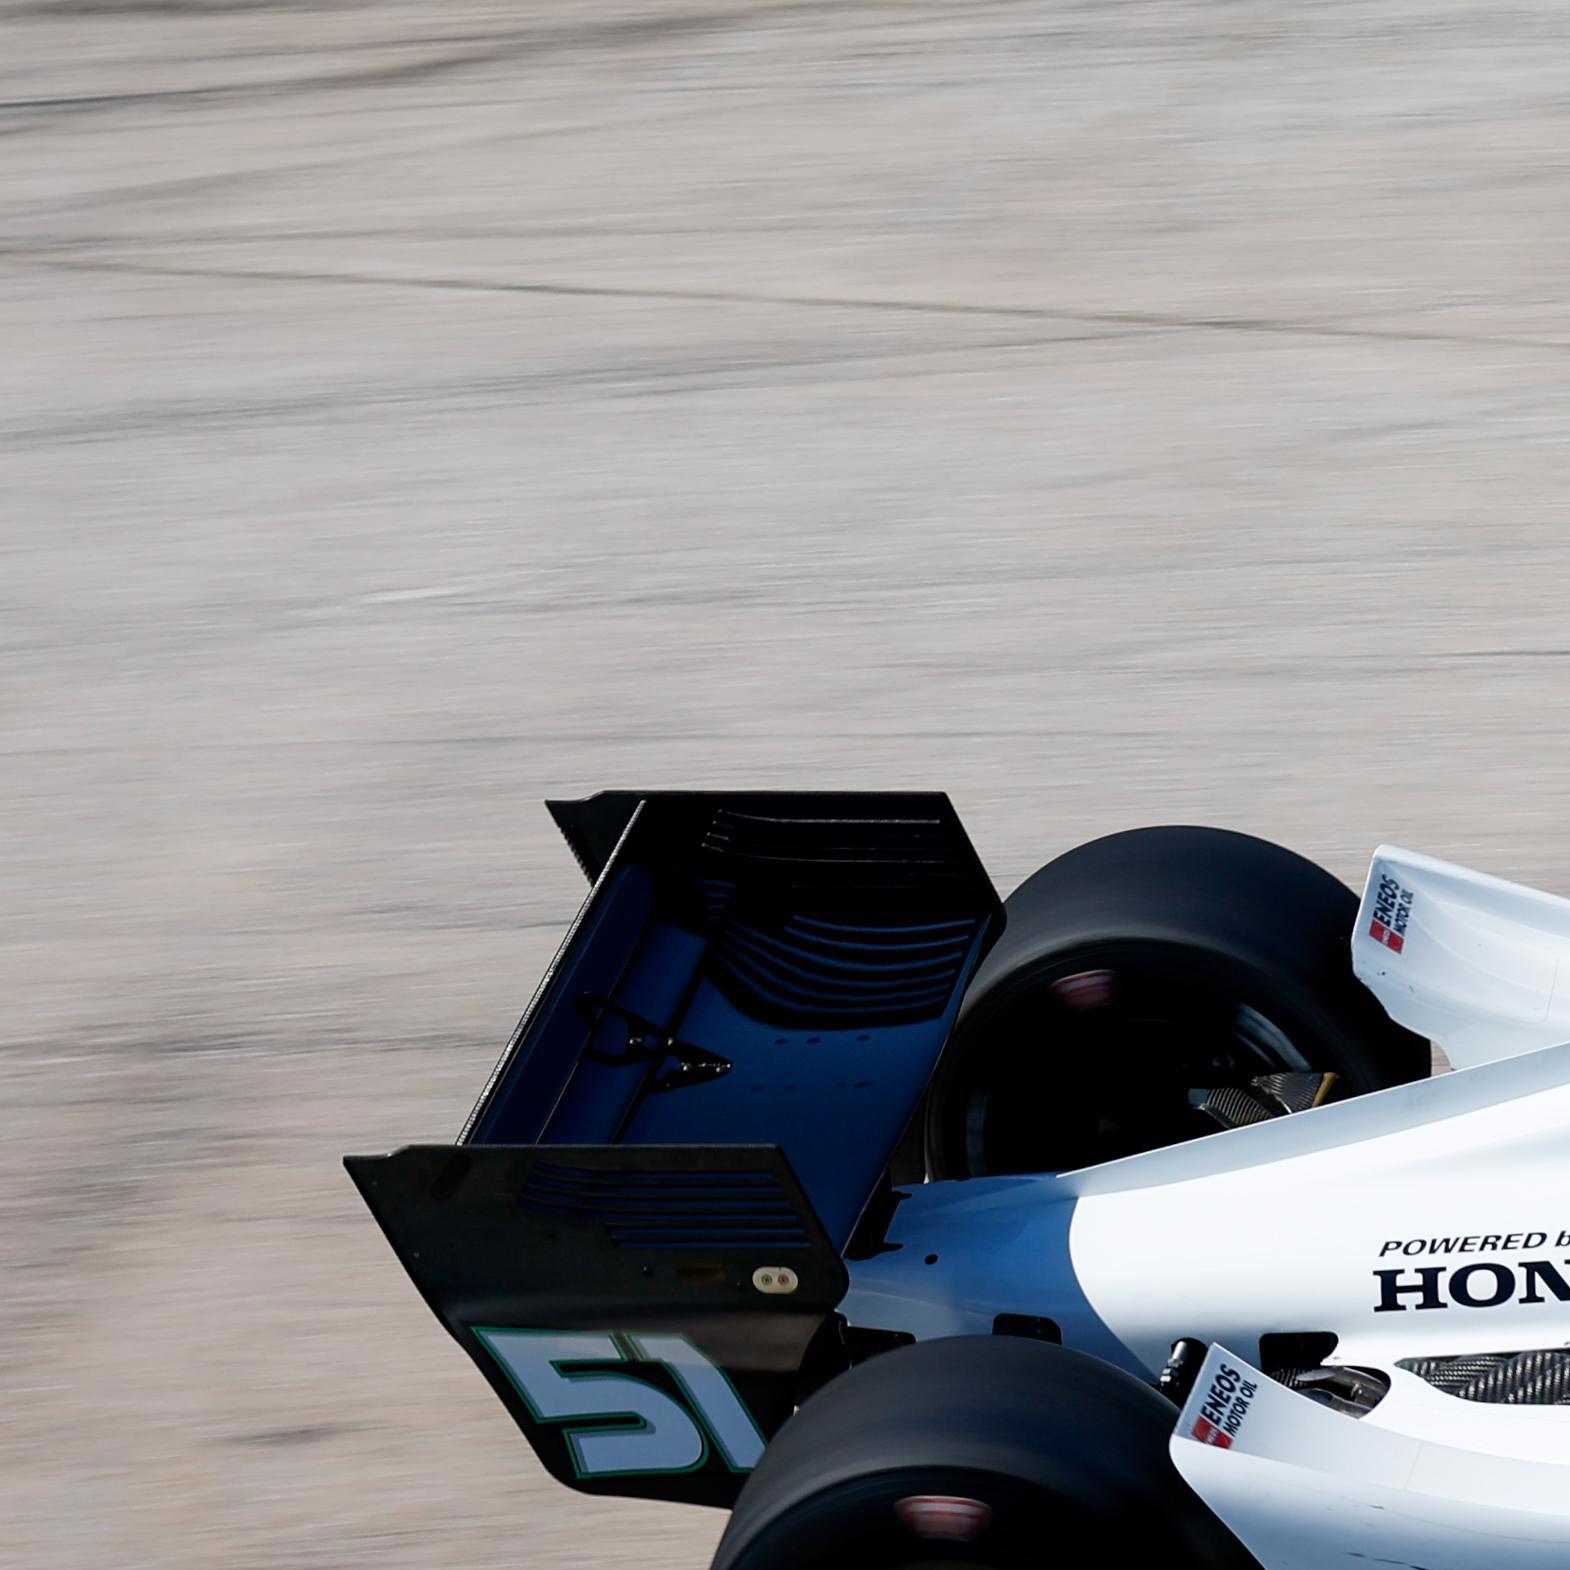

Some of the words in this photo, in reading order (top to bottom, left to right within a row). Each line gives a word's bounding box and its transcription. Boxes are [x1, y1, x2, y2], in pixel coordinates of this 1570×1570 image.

[1373, 874, 1400, 927] ENEOS
[1378, 1231, 1547, 1257] POWERED
[470, 1326, 769, 1479] 51
[1200, 1364, 1241, 1426] ENEOS
[1223, 1396, 1251, 1437] MOTOR
[1239, 1379, 1258, 1399] OIL
